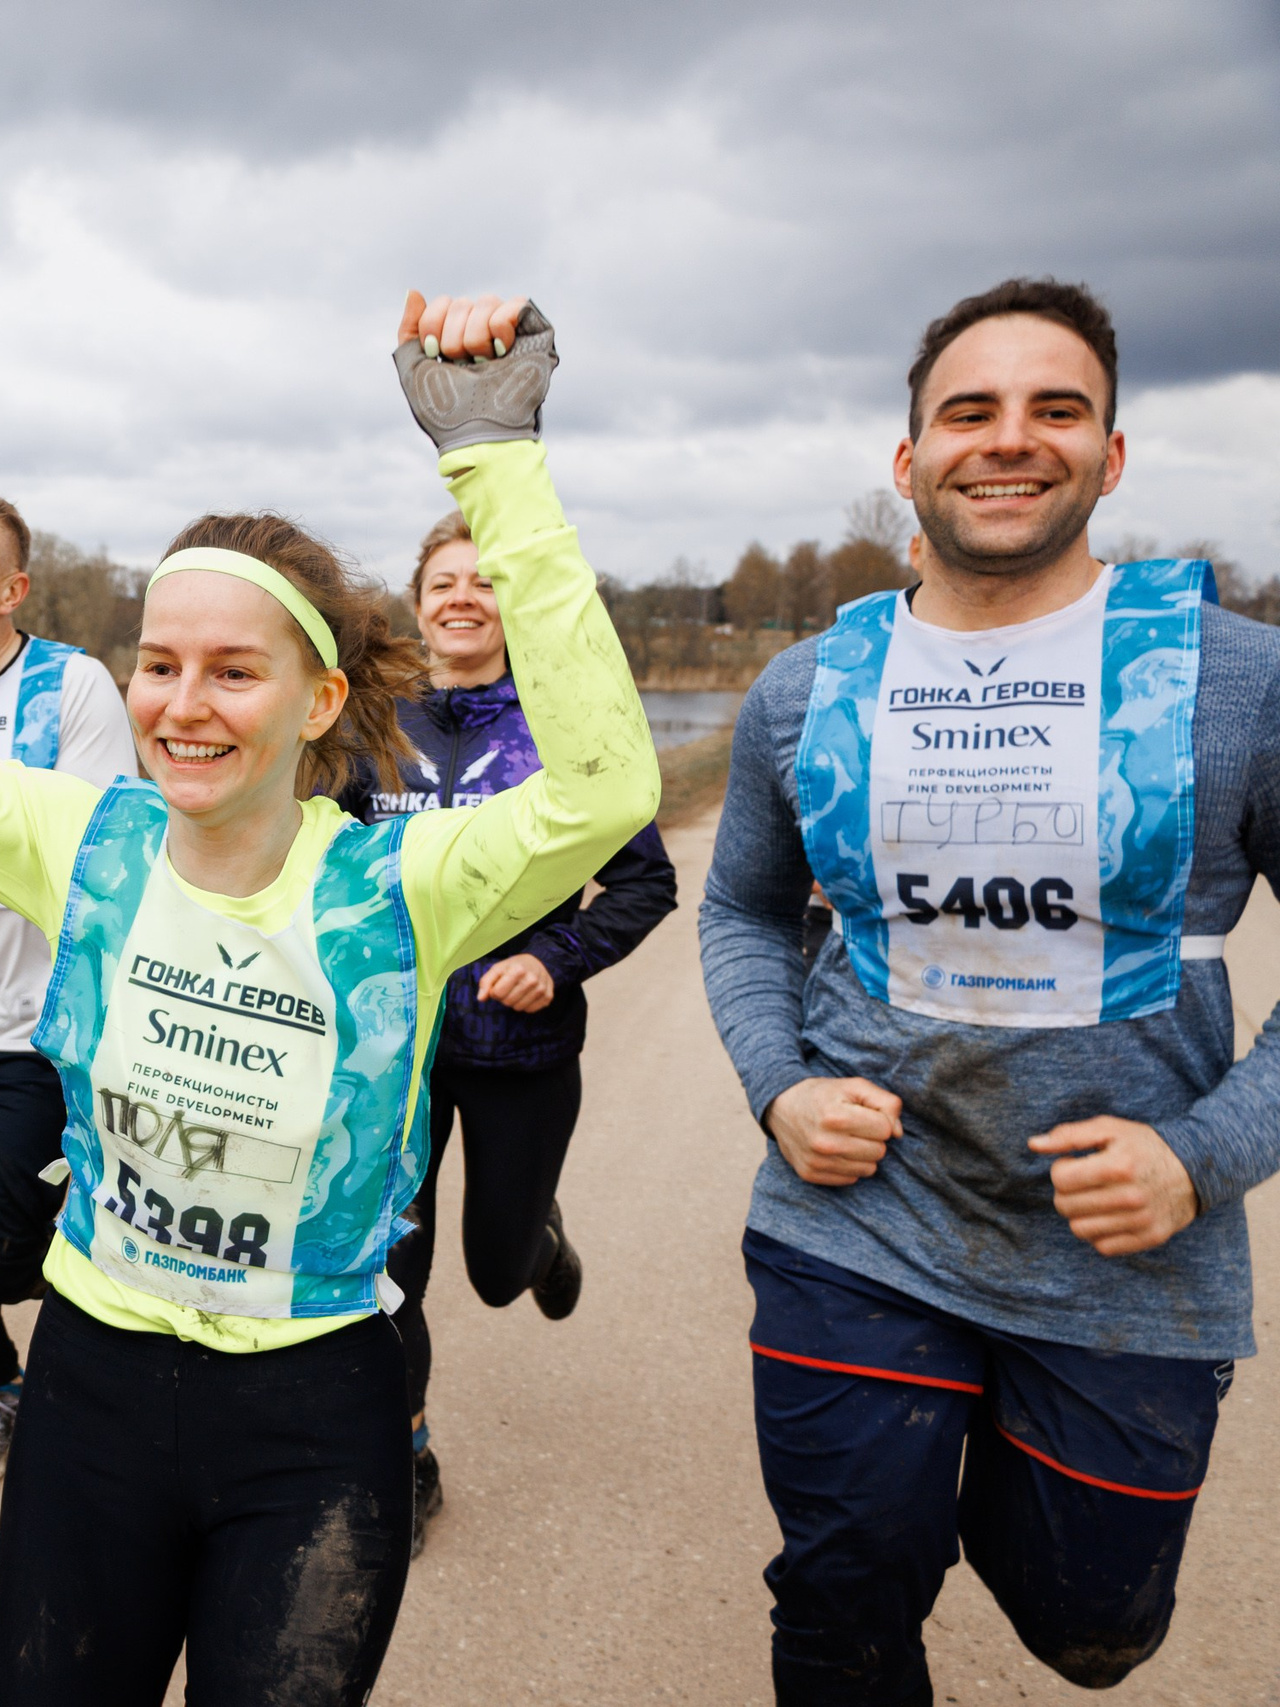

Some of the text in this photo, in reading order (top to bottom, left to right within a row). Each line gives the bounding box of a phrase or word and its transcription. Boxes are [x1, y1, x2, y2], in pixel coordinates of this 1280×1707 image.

[889, 681, 1086, 706] ГОНКА ГЕРОЕВ
[911, 722, 1052, 751] Sminex
[907, 781, 1052, 795] FINE DEVELOPMENT
[908, 765, 1053, 778] ПЕРФЕКЦИОНИСТЫ
[896, 873, 1078, 931] 5406
[130, 954, 327, 1027] ГОНКА ГЕРОЕВ
[950, 973, 1057, 992] ГАЗПРОМБАНК
[142, 1007, 289, 1078] Sminex
[126, 1081, 275, 1130] FINE DEVELOPMENT
[132, 1062, 280, 1112] ПЕРФЕКЦИОНИСТЫ
[104, 1158, 270, 1268] 5398
[144, 1250, 248, 1284] ГАЗПРОМБАНК
